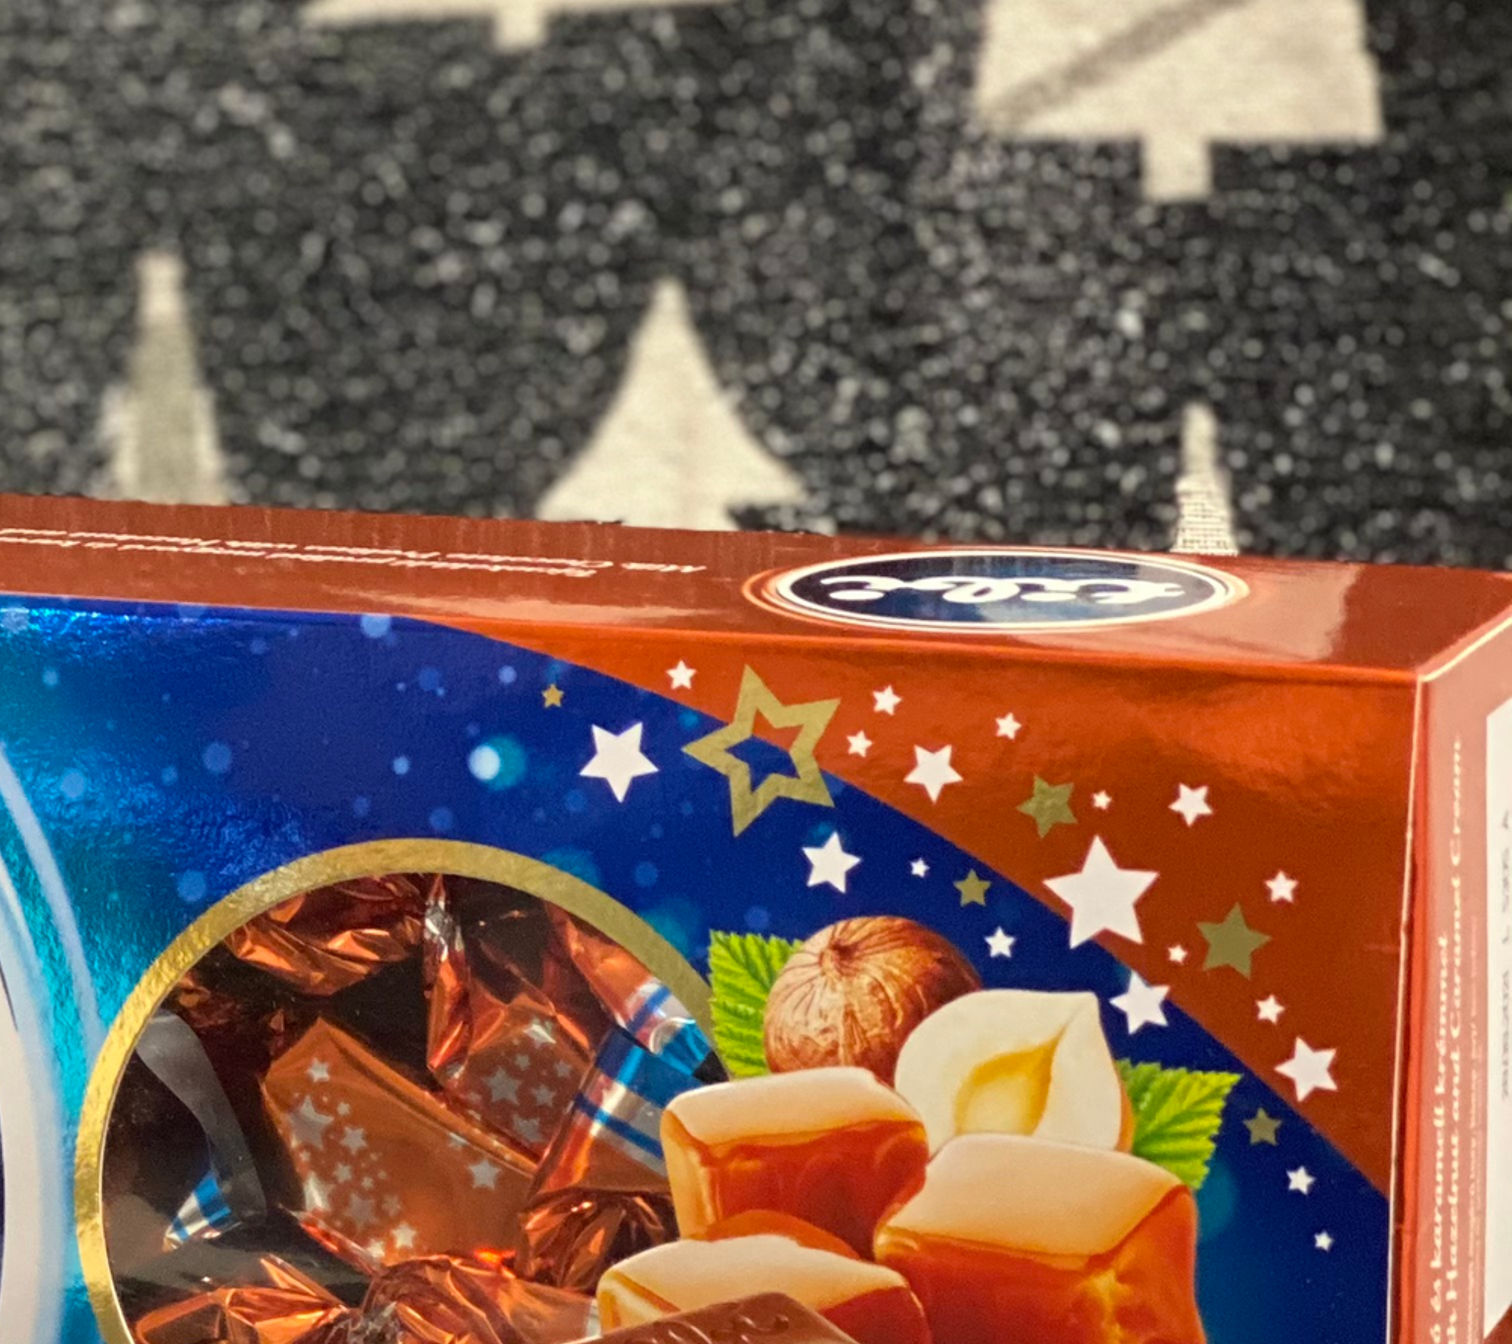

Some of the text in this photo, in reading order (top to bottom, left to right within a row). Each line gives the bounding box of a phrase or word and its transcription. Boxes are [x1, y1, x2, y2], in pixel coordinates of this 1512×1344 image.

[1450, 737, 1462, 867] Cream
[1434, 930, 1448, 1094] krémmel
[1450, 875, 1461, 1038] Caramel
[1450, 1043, 1461, 1121] and
[1430, 1100, 1443, 1269] karamell
[1446, 1130, 1460, 1301] Hazelnut
[1430, 1278, 1441, 1312] és
